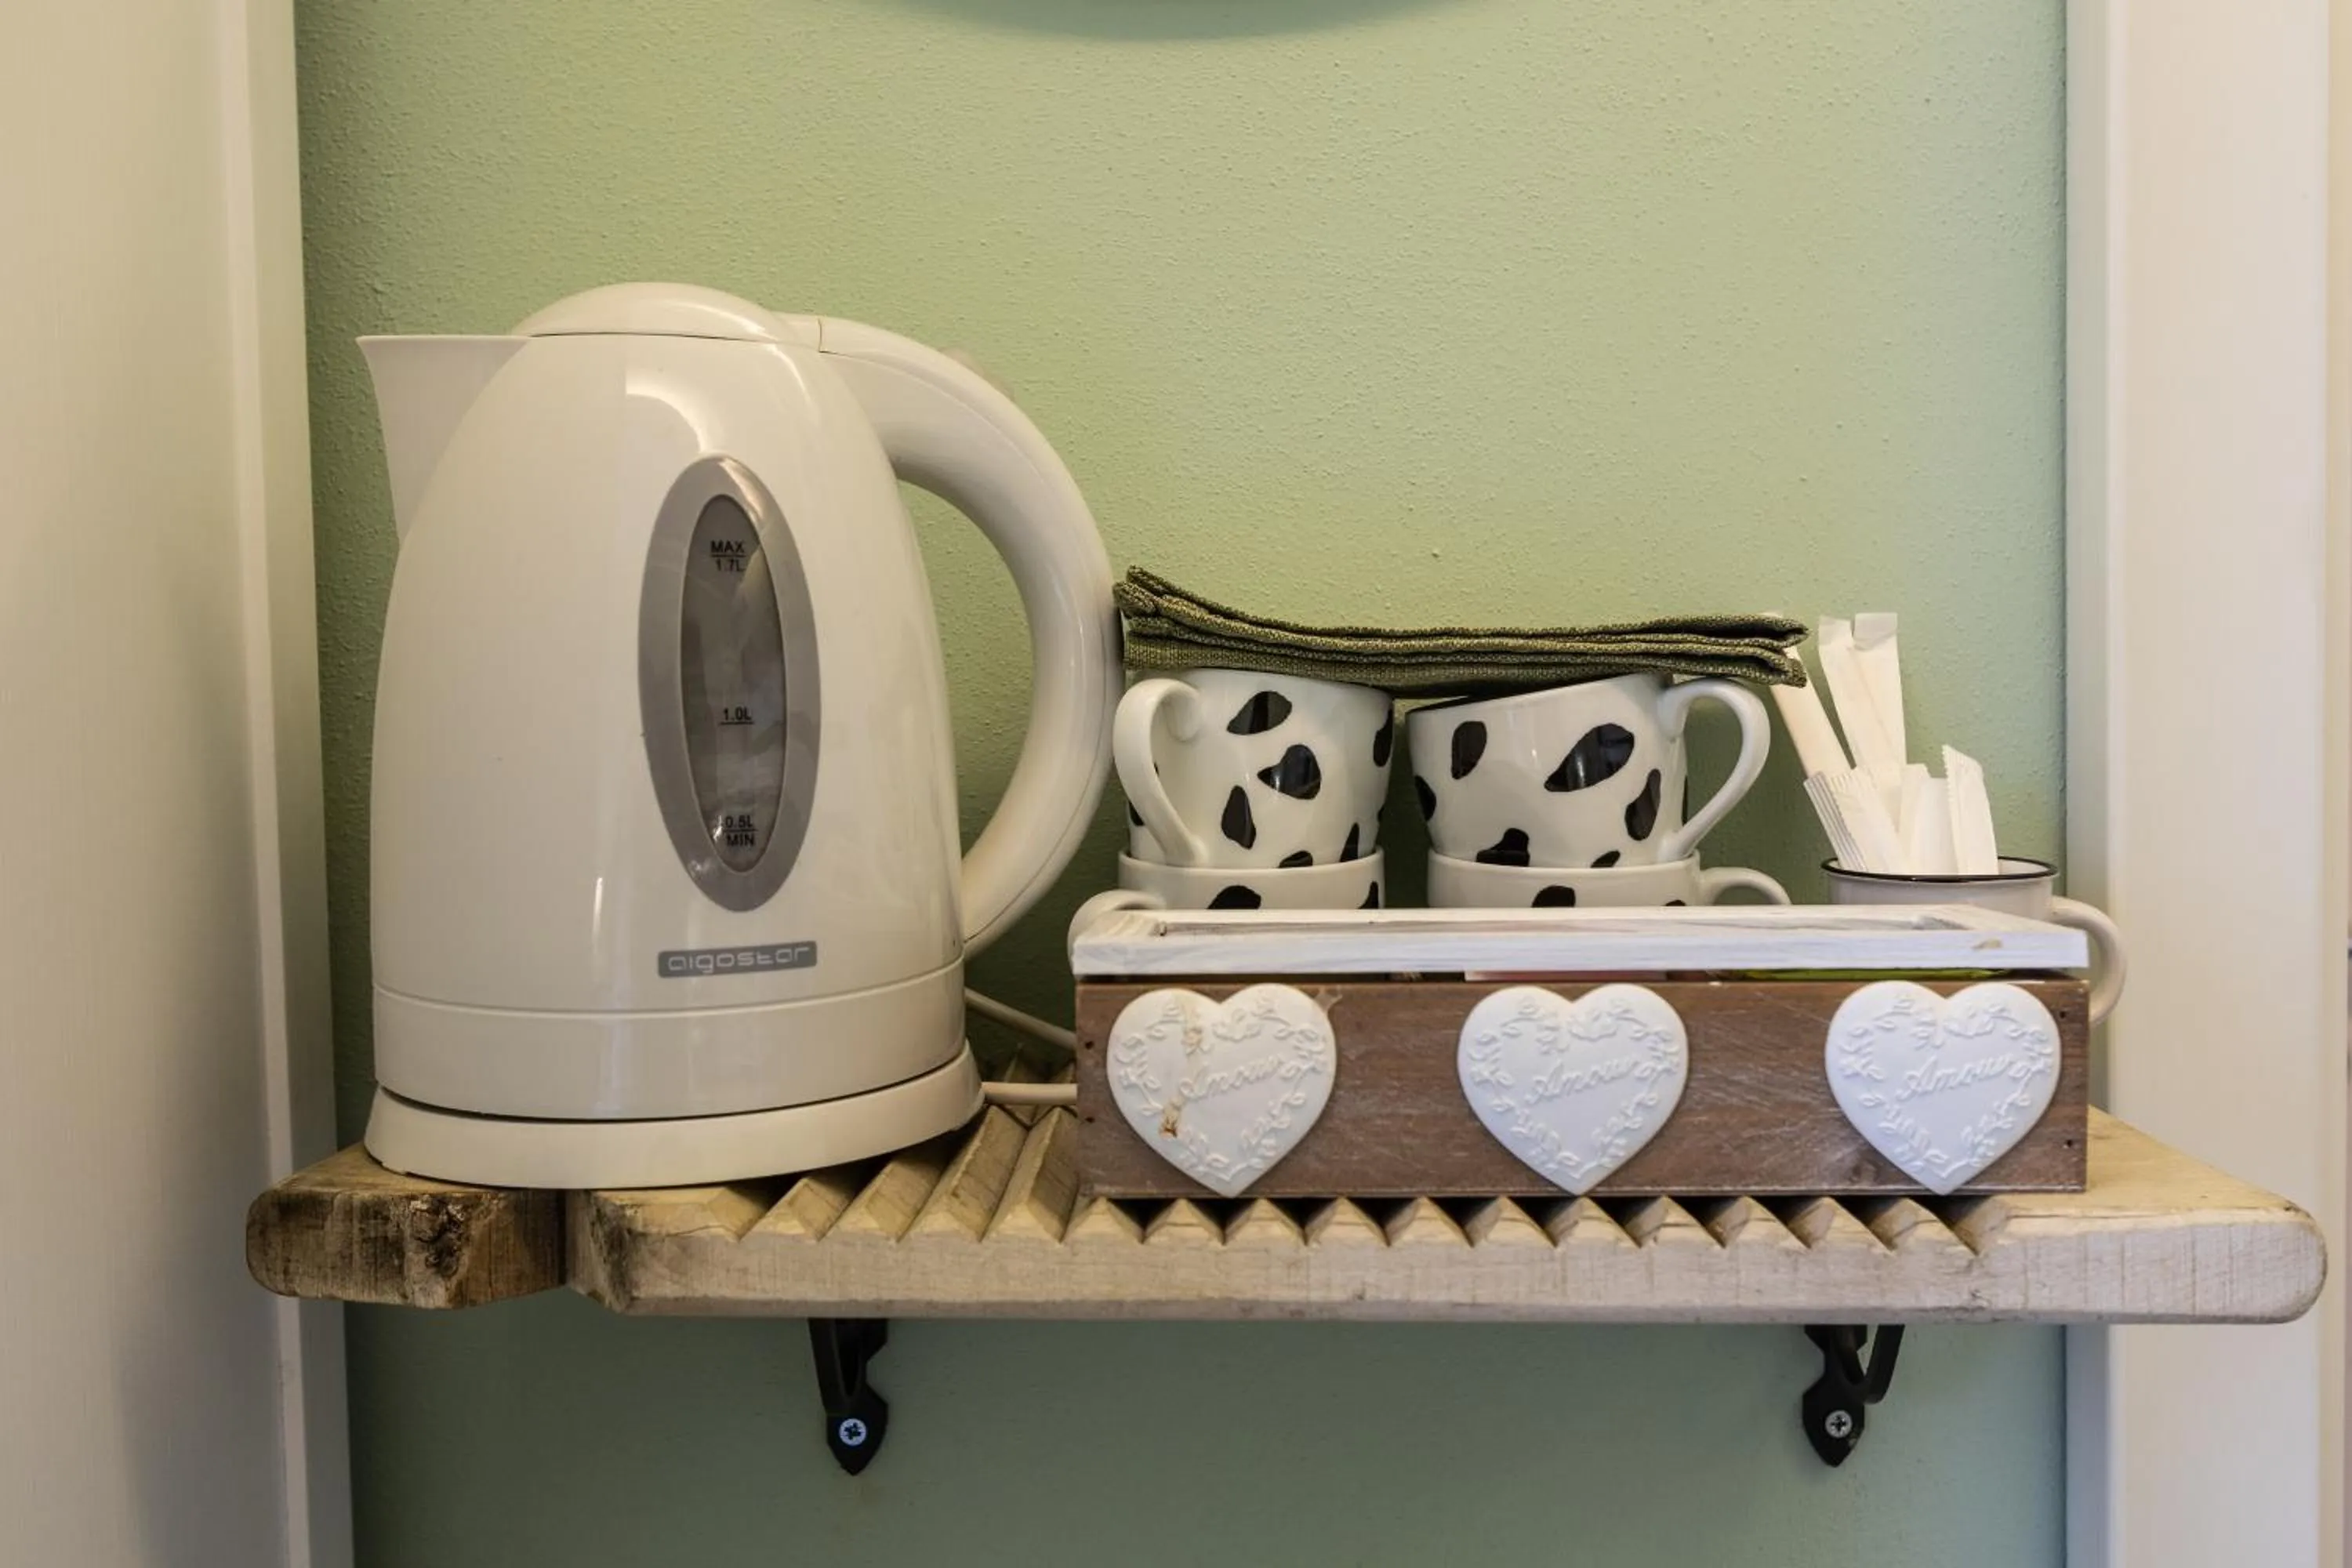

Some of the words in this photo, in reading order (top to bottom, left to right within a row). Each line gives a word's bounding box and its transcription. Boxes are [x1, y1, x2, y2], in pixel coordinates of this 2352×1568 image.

[710, 539, 745, 553] MAX
[723, 706, 752, 720] 1.0L
[727, 833, 755, 847] MIN
[668, 946, 810, 973] aigostar
